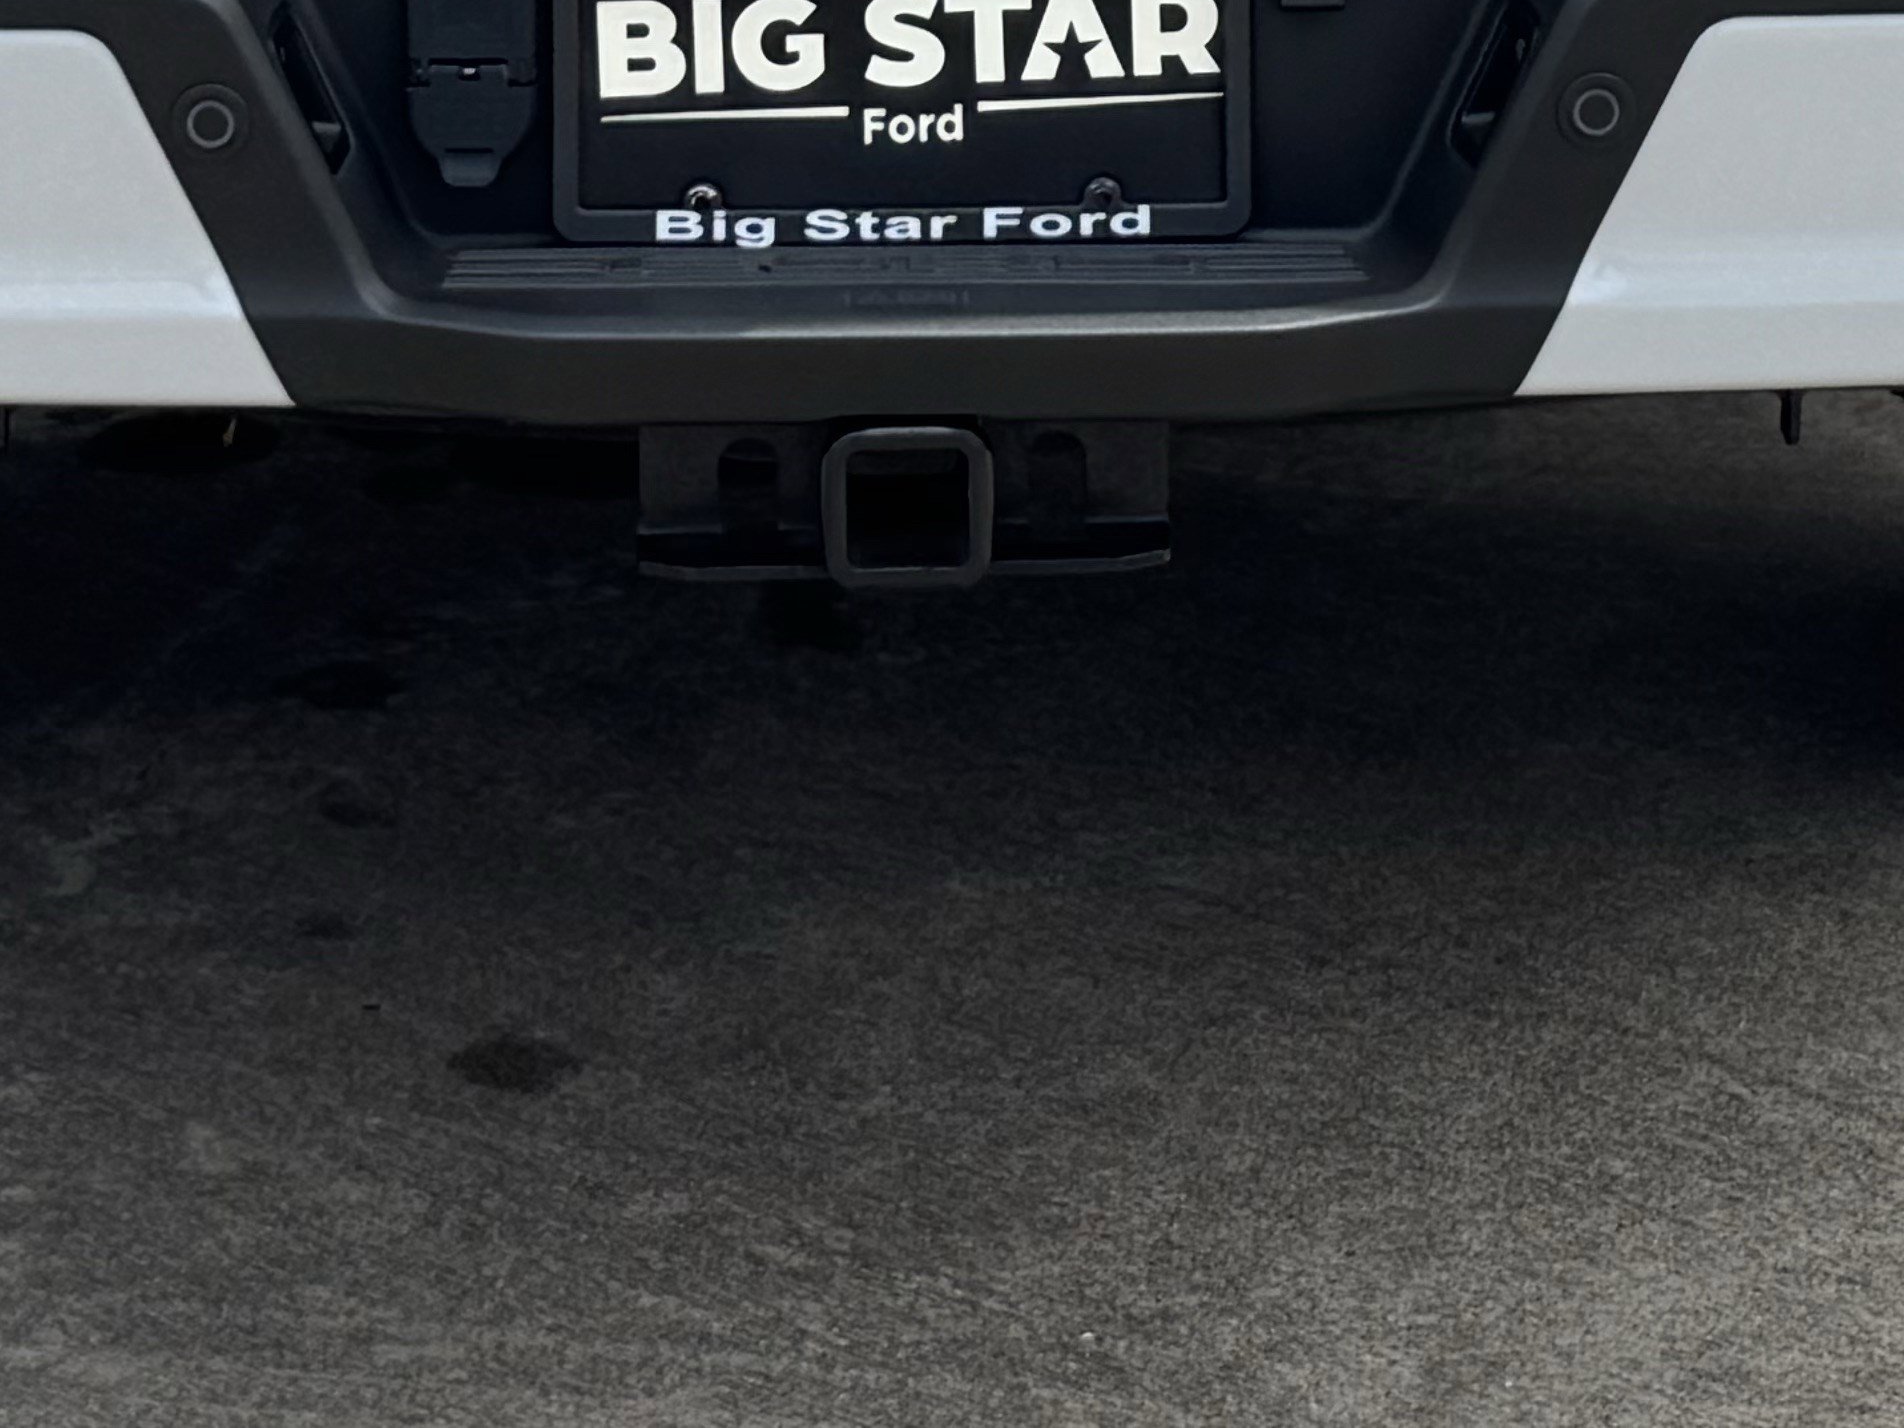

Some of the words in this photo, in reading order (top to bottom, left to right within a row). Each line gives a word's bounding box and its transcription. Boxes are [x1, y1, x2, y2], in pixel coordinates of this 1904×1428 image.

[862, 103, 965, 146] Ford
[655, 209, 776, 248] Big
[803, 208, 958, 241] Star
[982, 204, 1151, 239] Ford
